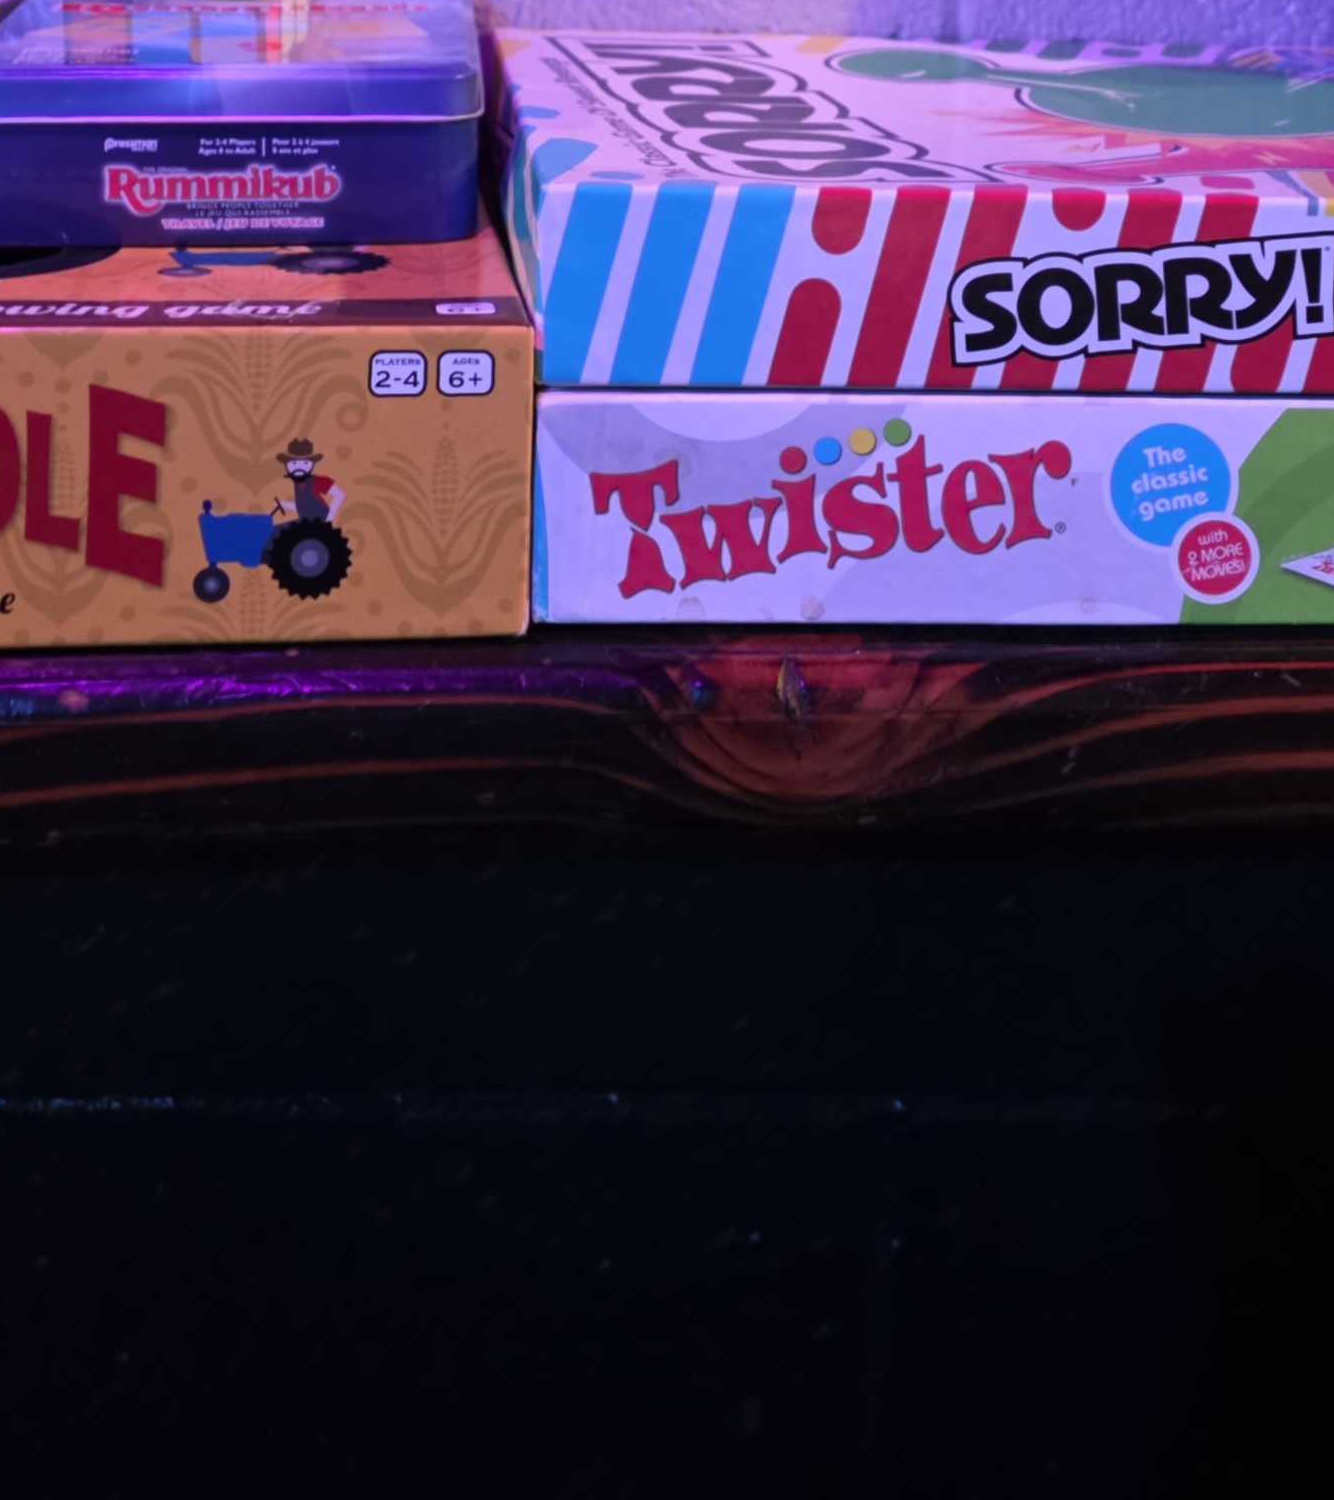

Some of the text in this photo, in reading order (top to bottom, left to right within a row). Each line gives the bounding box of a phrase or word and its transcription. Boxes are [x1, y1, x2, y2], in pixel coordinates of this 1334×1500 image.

[198, 147, 217, 156] Ages
[235, 147, 256, 155] Adult
[200, 138, 213, 146] For
[229, 138, 256, 147] Players
[104, 164, 340, 216] Rummikub
[186, 202, 218, 210] BRINGS
[161, 218, 215, 229] TRAVEL
[224, 218, 249, 230] JEU
[271, 217, 324, 228] VOYAGE
[955, 240, 1332, 358] SORRY!
[375, 358, 421, 366] PLAYERS
[452, 357, 480, 365] AGES
[374, 370, 419, 388] 2-4
[448, 370, 482, 388] 6+
[1143, 446, 1187, 468] The
[1131, 463, 1208, 494] classic
[1138, 490, 1209, 522] game
[588, 432, 1072, 600] Twister
[1198, 528, 1228, 545] with
[1188, 541, 1244, 565] 2 MORE
[1191, 559, 1245, 581] MOVES!
